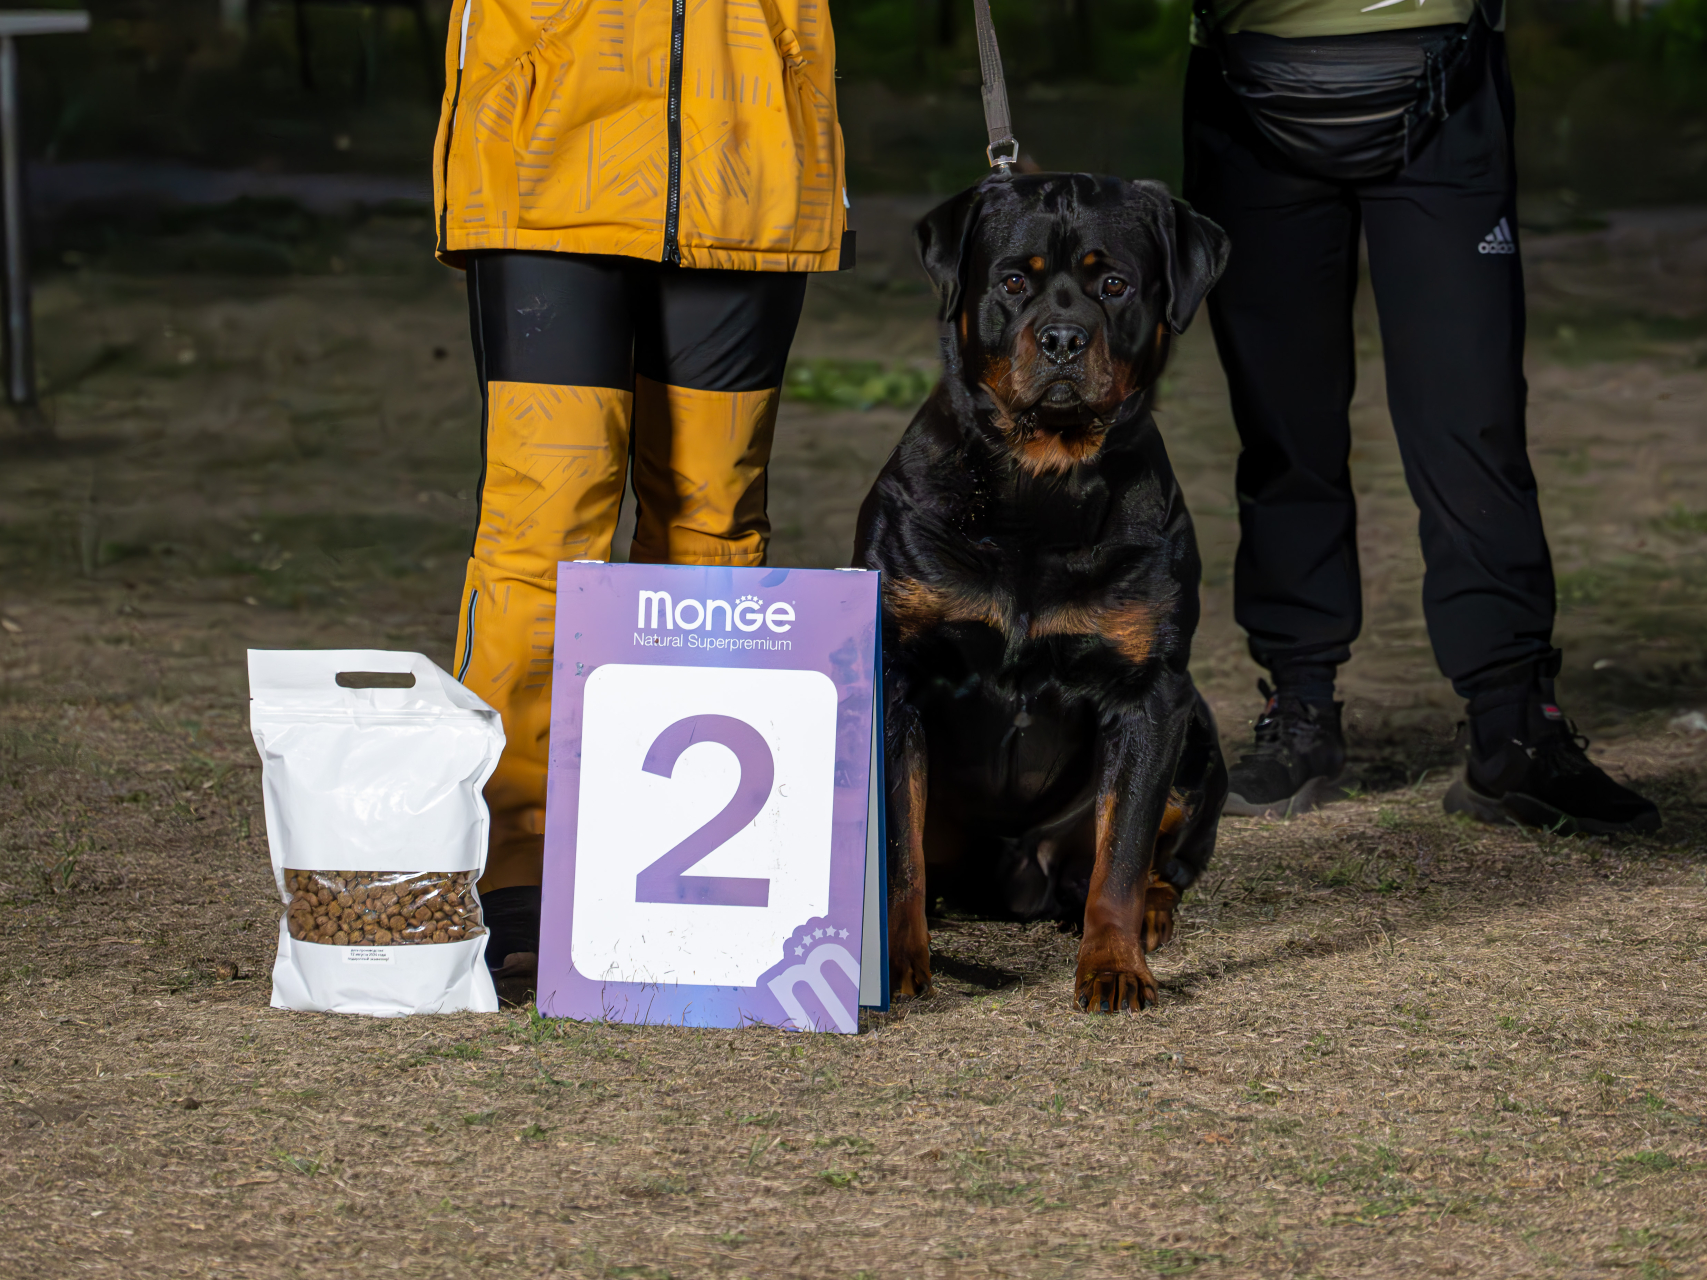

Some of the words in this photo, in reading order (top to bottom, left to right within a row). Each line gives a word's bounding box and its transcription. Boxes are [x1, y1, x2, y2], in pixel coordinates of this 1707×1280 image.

[633, 632, 684, 648] Natural
[688, 633, 792, 652] Superpremium
[635, 713, 775, 908] 2
